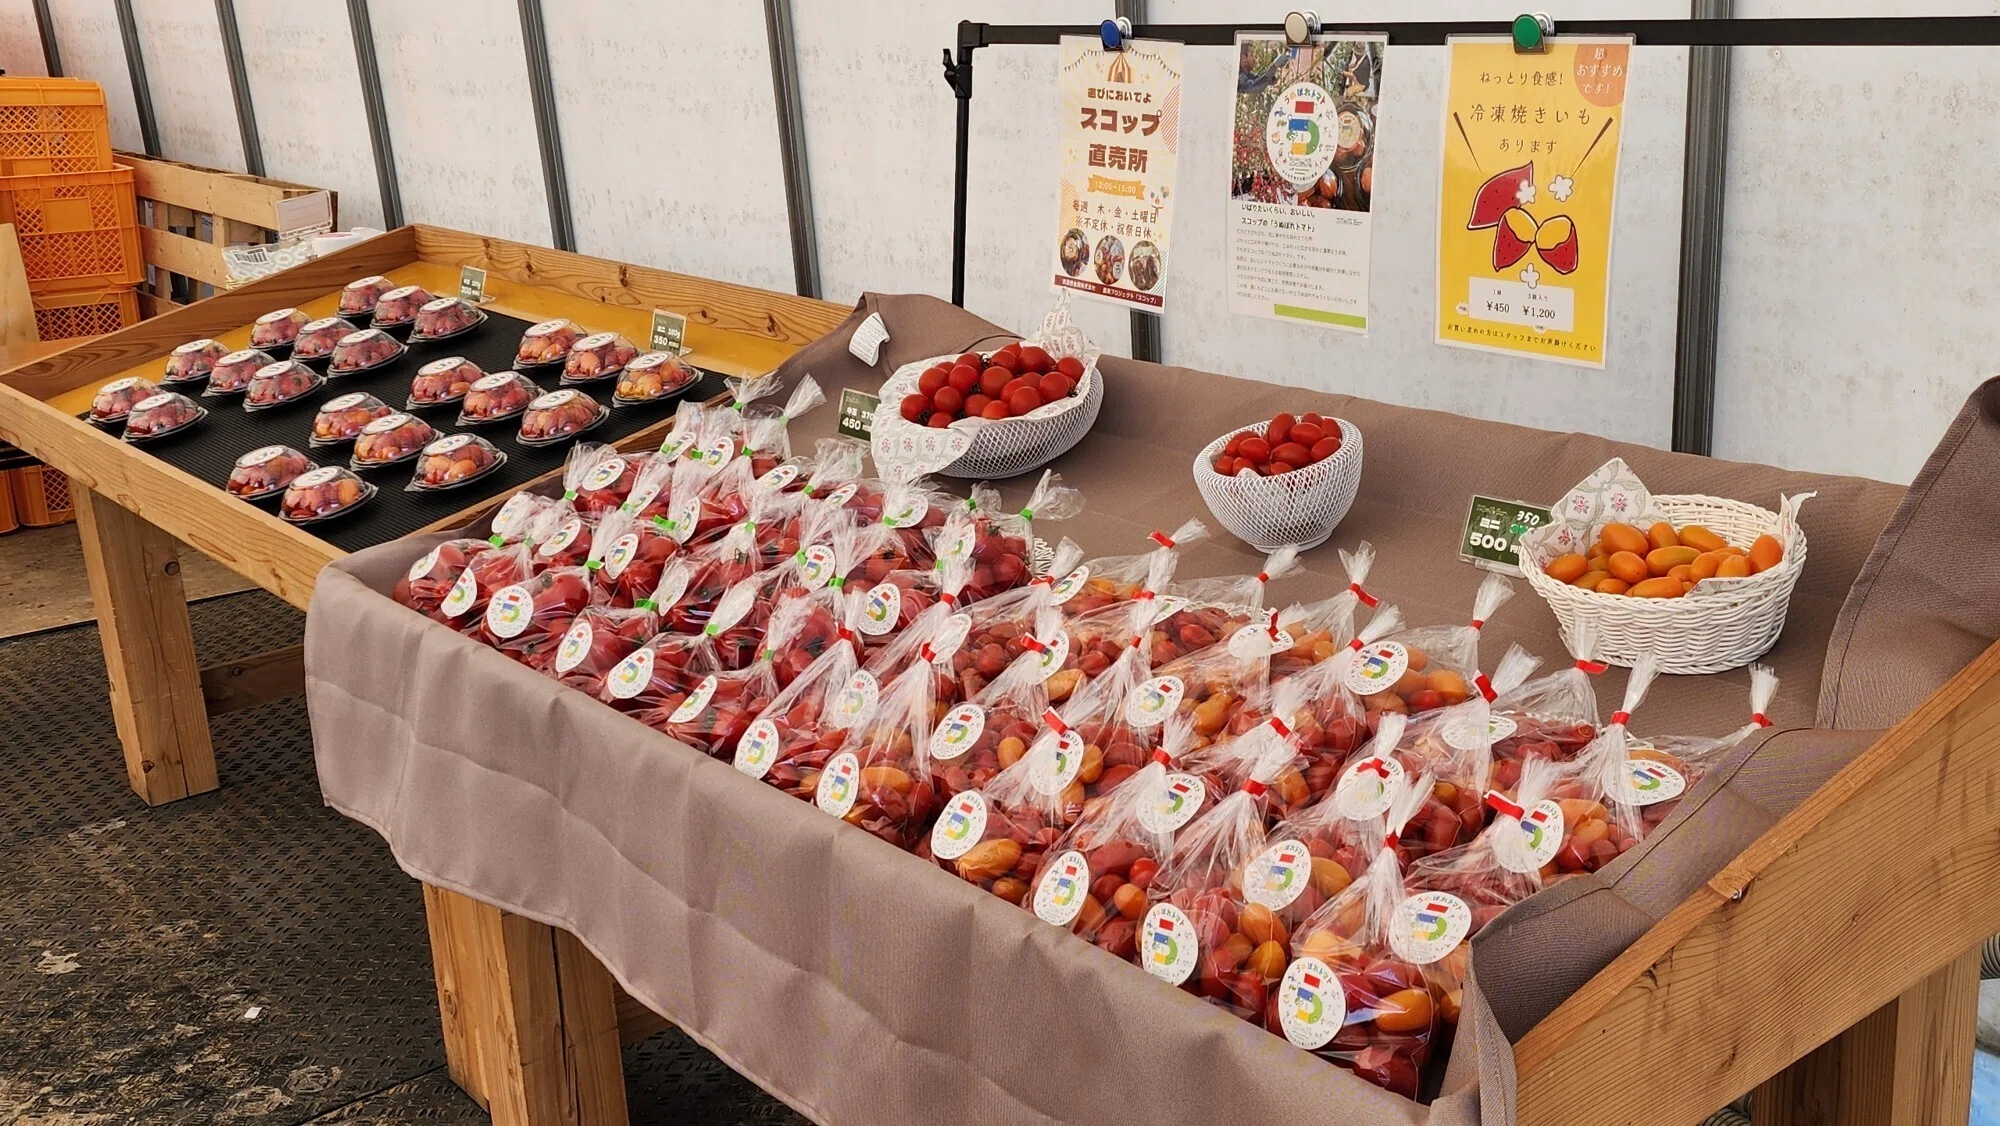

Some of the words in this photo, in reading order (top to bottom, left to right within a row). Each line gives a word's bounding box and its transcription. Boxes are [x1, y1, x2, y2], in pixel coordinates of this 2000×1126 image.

[1594, 47, 1605, 60] 超
[1577, 64, 1623, 77] おすすめ
[1088, 87, 1152, 103] 遊びにおいてよ
[1080, 107, 1162, 137] スコップ
[1470, 103, 1591, 125] 冷凍焼きいも
[1499, 138, 1558, 154] あります
[1088, 143, 1148, 173] 直売所
[1241, 217, 1316, 233] スコップの「うぬぼれトマト」
[1486, 300, 1510, 314] ¥450
[1522, 305, 1556, 320] ¥1,200
[653, 335, 668, 346] 350
[842, 417, 862, 431] 450
[1479, 517, 1501, 530] ミニ
[1517, 510, 1540, 526] 350
[1469, 531, 1507, 552] 500
